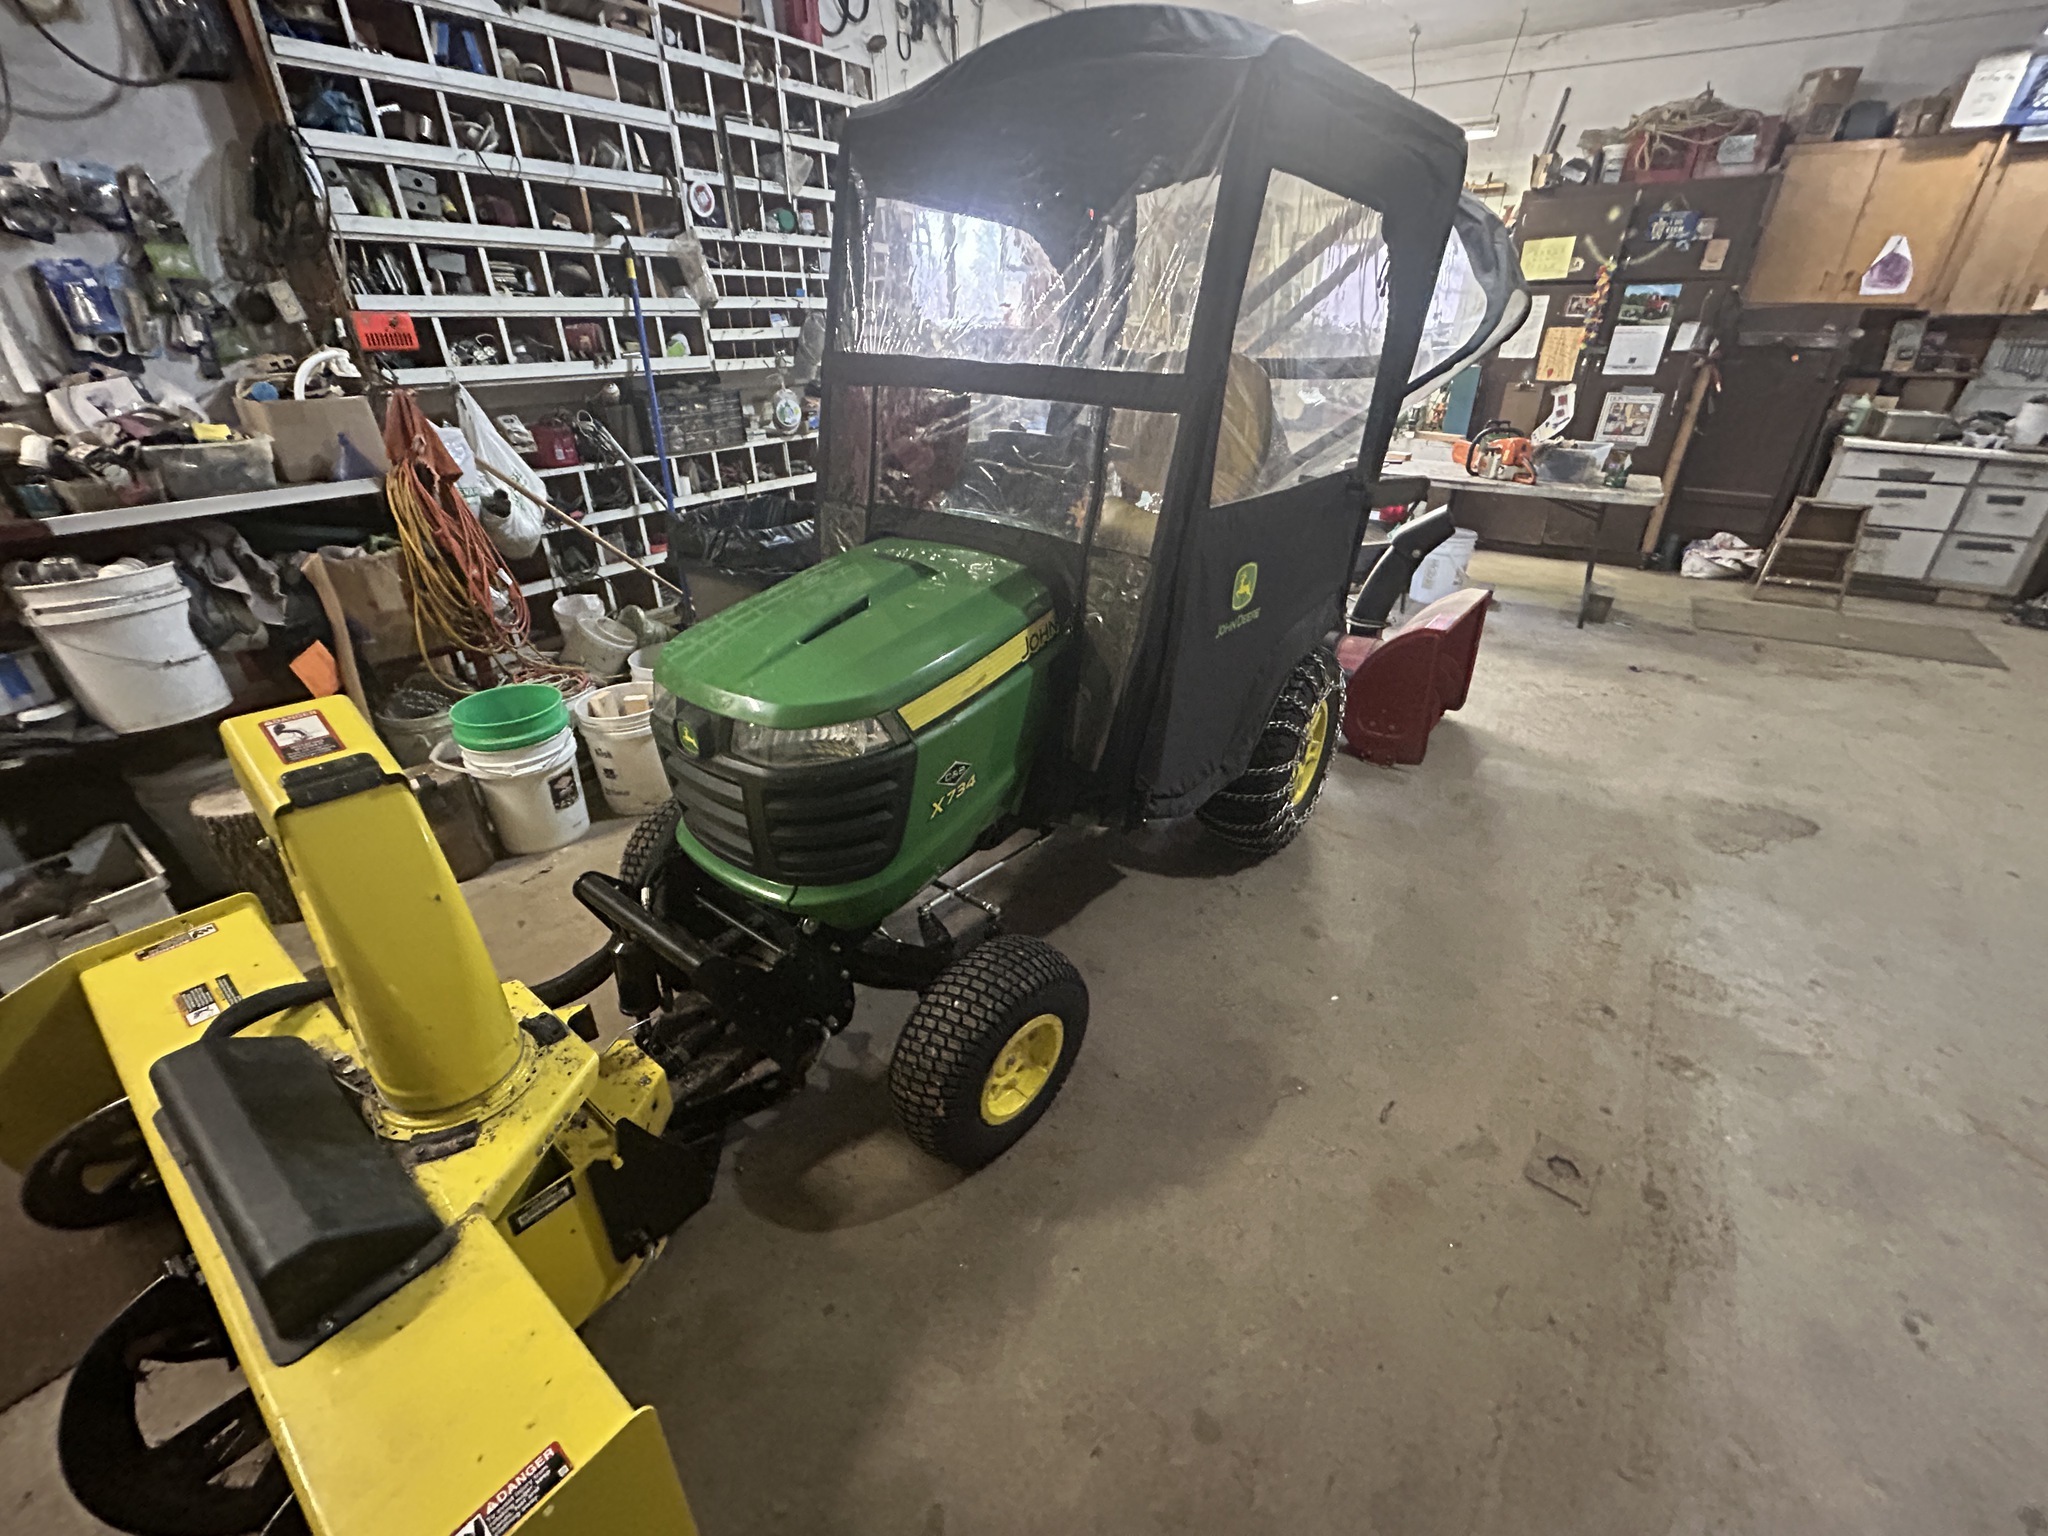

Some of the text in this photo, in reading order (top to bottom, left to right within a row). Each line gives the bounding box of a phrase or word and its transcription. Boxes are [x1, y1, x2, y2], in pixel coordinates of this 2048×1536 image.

[1021, 621, 1058, 660] JOHN
[930, 774, 976, 820] X734
[496, 1447, 555, 1504] DANGER
